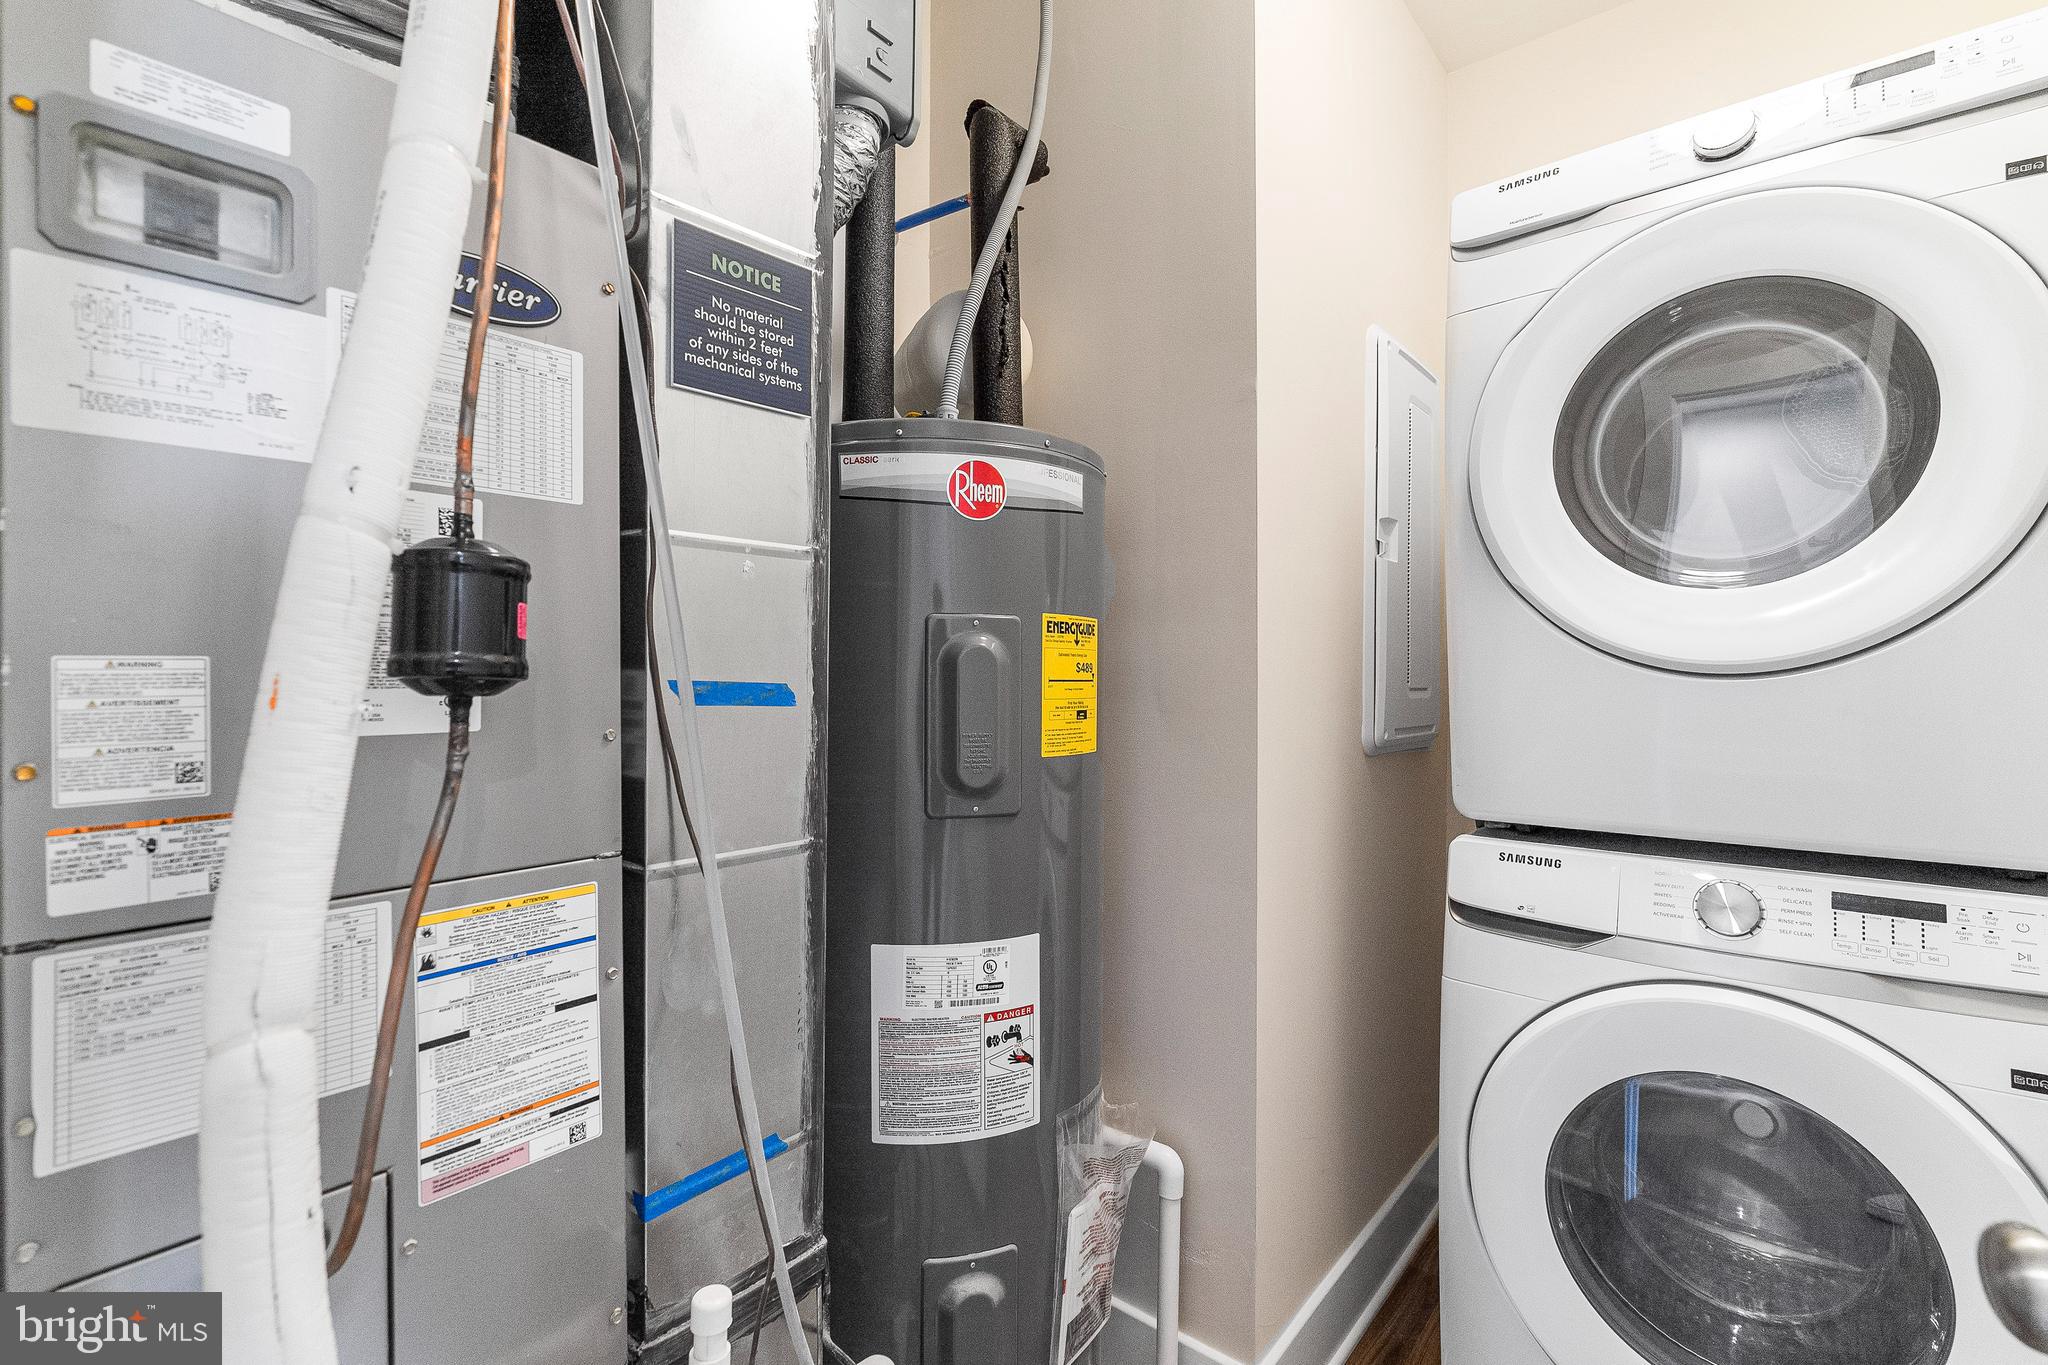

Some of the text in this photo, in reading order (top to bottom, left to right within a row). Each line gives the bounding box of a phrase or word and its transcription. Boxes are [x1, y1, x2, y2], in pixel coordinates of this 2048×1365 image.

[1498, 167, 1560, 193] SAMSUNG
[712, 253, 781, 293] NOTICE
[455, 273, 541, 310] arier
[694, 307, 794, 347] should be stored
[712, 295, 784, 329] No material
[689, 337, 799, 376] of any sides of the
[708, 328, 783, 358] within 2 feet
[684, 353, 803, 392] mechanical systems
[843, 456, 879, 465] CLASSIC
[955, 461, 1003, 510] Rheem
[1046, 620, 1095, 636] ENERGYGUIDE
[1499, 852, 1562, 869] SAMSUNG
[472, 894, 549, 914] CAUTION ATTENTION
[1782, 898, 1813, 906] DELICATES
[996, 1007, 1031, 1020] DANGER
